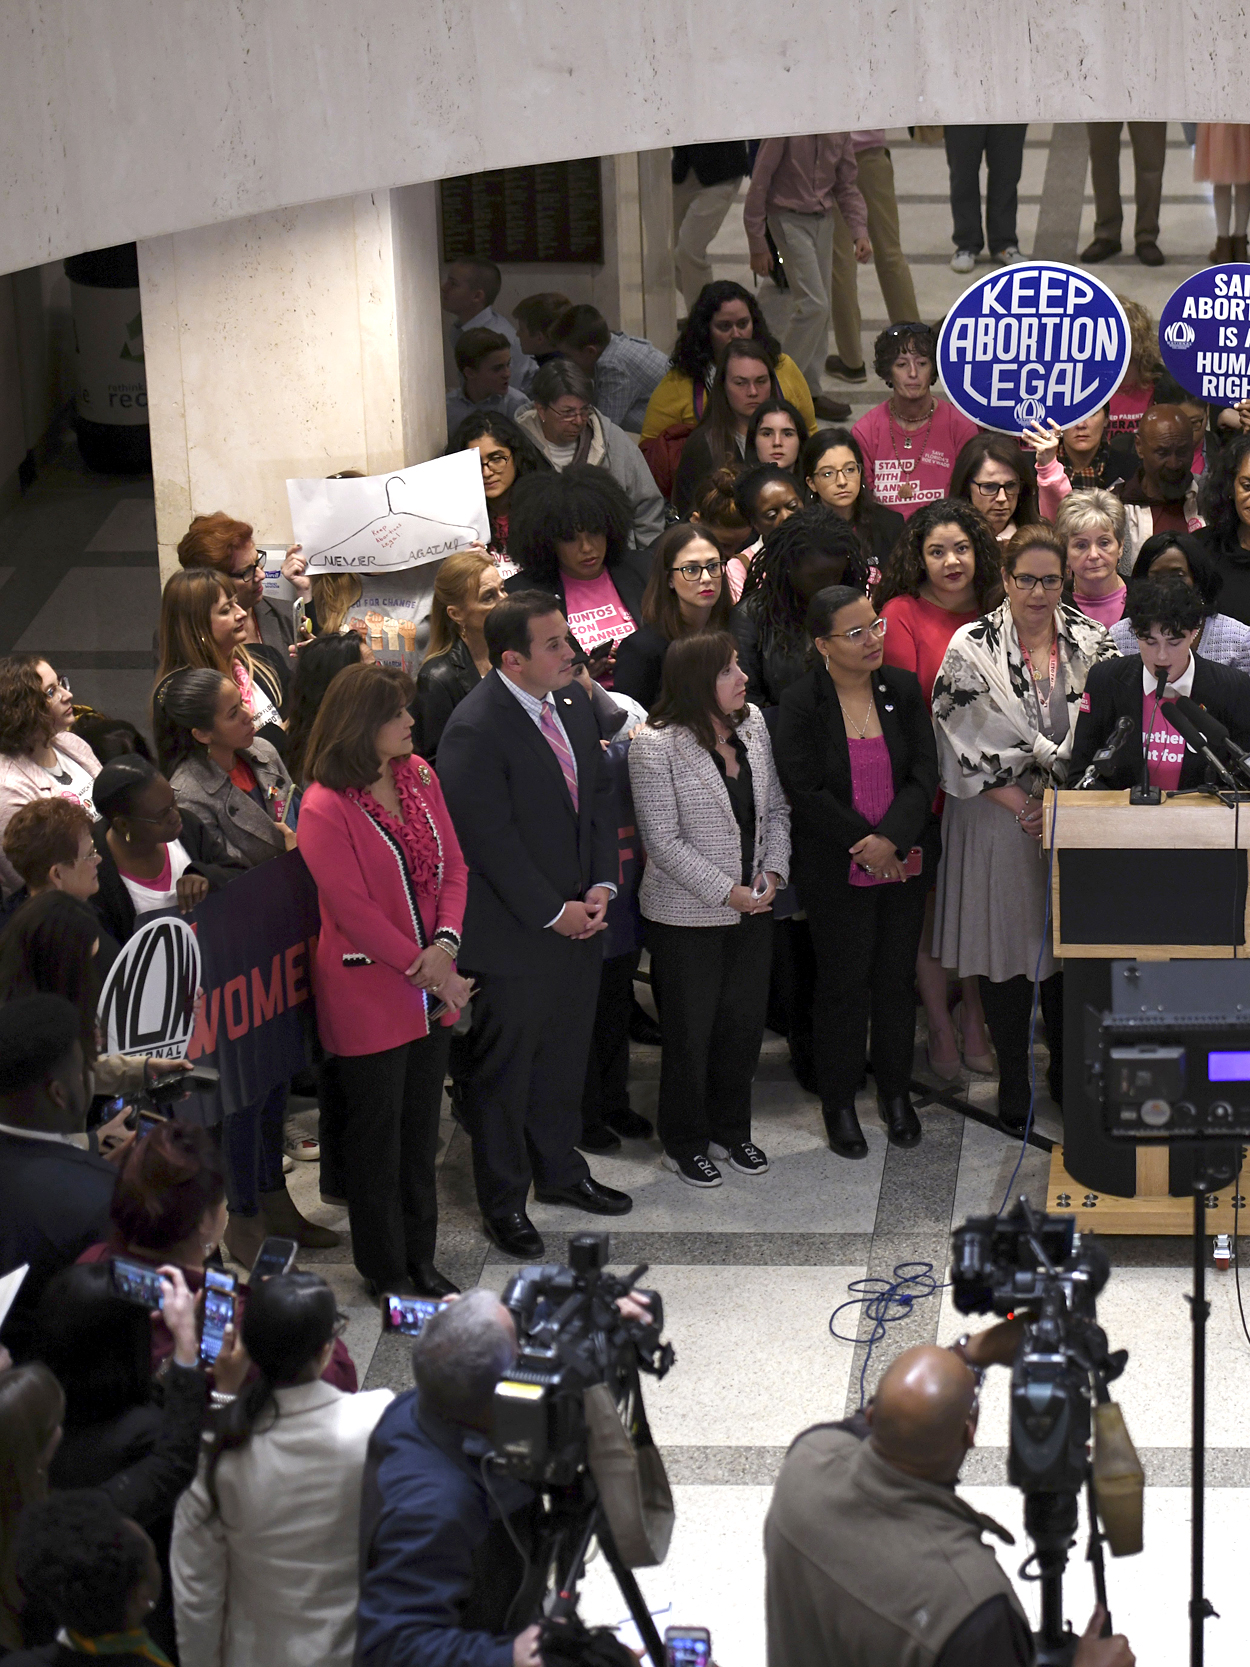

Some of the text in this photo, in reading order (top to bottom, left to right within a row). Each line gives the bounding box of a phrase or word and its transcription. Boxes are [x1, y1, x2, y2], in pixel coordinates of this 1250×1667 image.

[982, 270, 1094, 314] KEEP
[949, 317, 1118, 361] ABORTION
[1218, 327, 1238, 347] IS
[963, 363, 1099, 407] LEGAL
[878, 461, 913, 470] STAND
[322, 555, 376, 567] NEVER
[382, 599, 416, 608] CHANGE
[568, 606, 613, 625] JUNTOS
[571, 623, 596, 636] CON
[1161, 749, 1184, 762] for
[101, 923, 198, 1053] NOW
